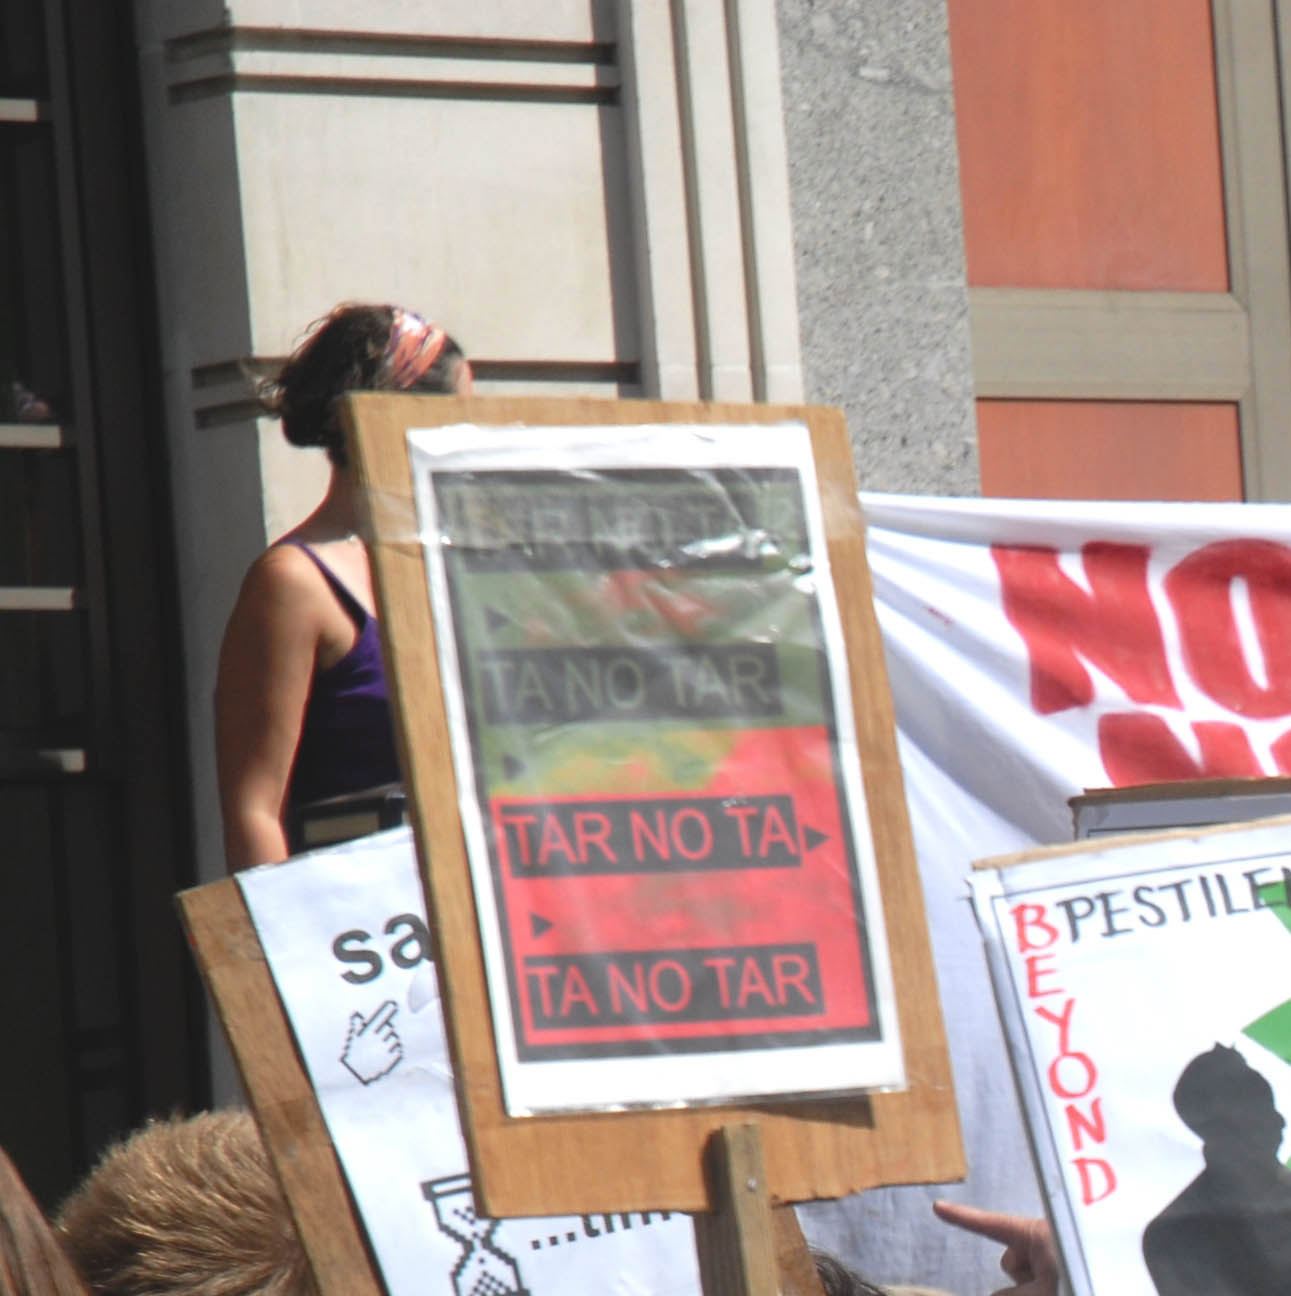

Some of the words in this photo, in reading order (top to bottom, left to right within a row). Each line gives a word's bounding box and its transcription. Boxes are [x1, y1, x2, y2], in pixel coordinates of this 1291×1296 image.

[558, 657, 643, 710] NO
[671, 653, 772, 706] TAR
[502, 810, 618, 867] TAR
[629, 808, 715, 862] NO
[724, 804, 800, 859] TA
[524, 963, 601, 1019] TA
[607, 960, 693, 1015] NO
[704, 953, 817, 1009] TAR
[1009, 902, 1118, 1207] BEYOND
